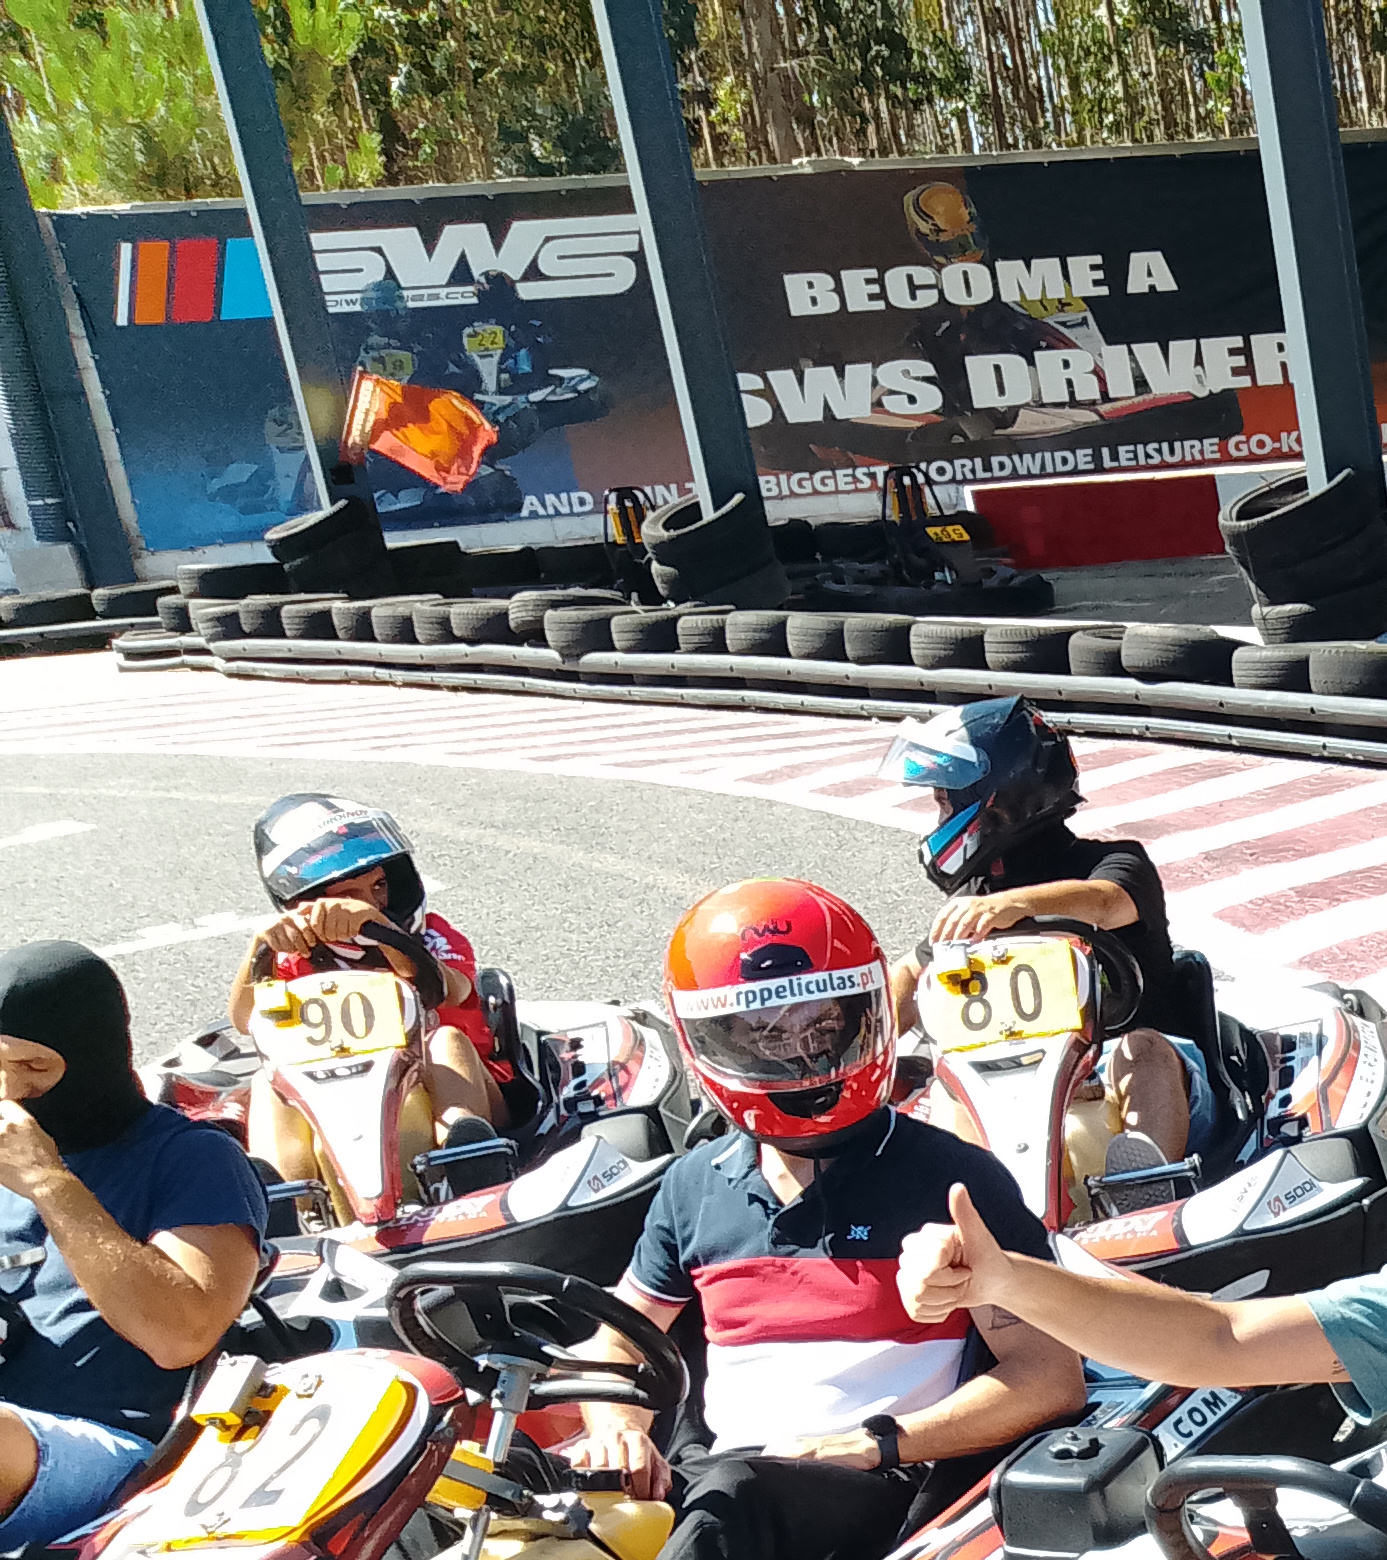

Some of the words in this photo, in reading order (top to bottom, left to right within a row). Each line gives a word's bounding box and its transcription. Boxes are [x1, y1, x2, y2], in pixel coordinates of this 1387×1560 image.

[783, 254, 1109, 317] BECOME
[1126, 250, 1178, 295] A
[737, 358, 943, 428] SWS
[965, 332, 1293, 409] DRIVER
[520, 490, 594, 517] AND
[760, 464, 888, 498] BIGGEST
[1101, 438, 1219, 470] LEISURE
[1228, 429, 1303, 458] GO-K
[301, 991, 376, 1046] 90
[961, 963, 1043, 1032] 80
[184, 1403, 332, 1517] 82
